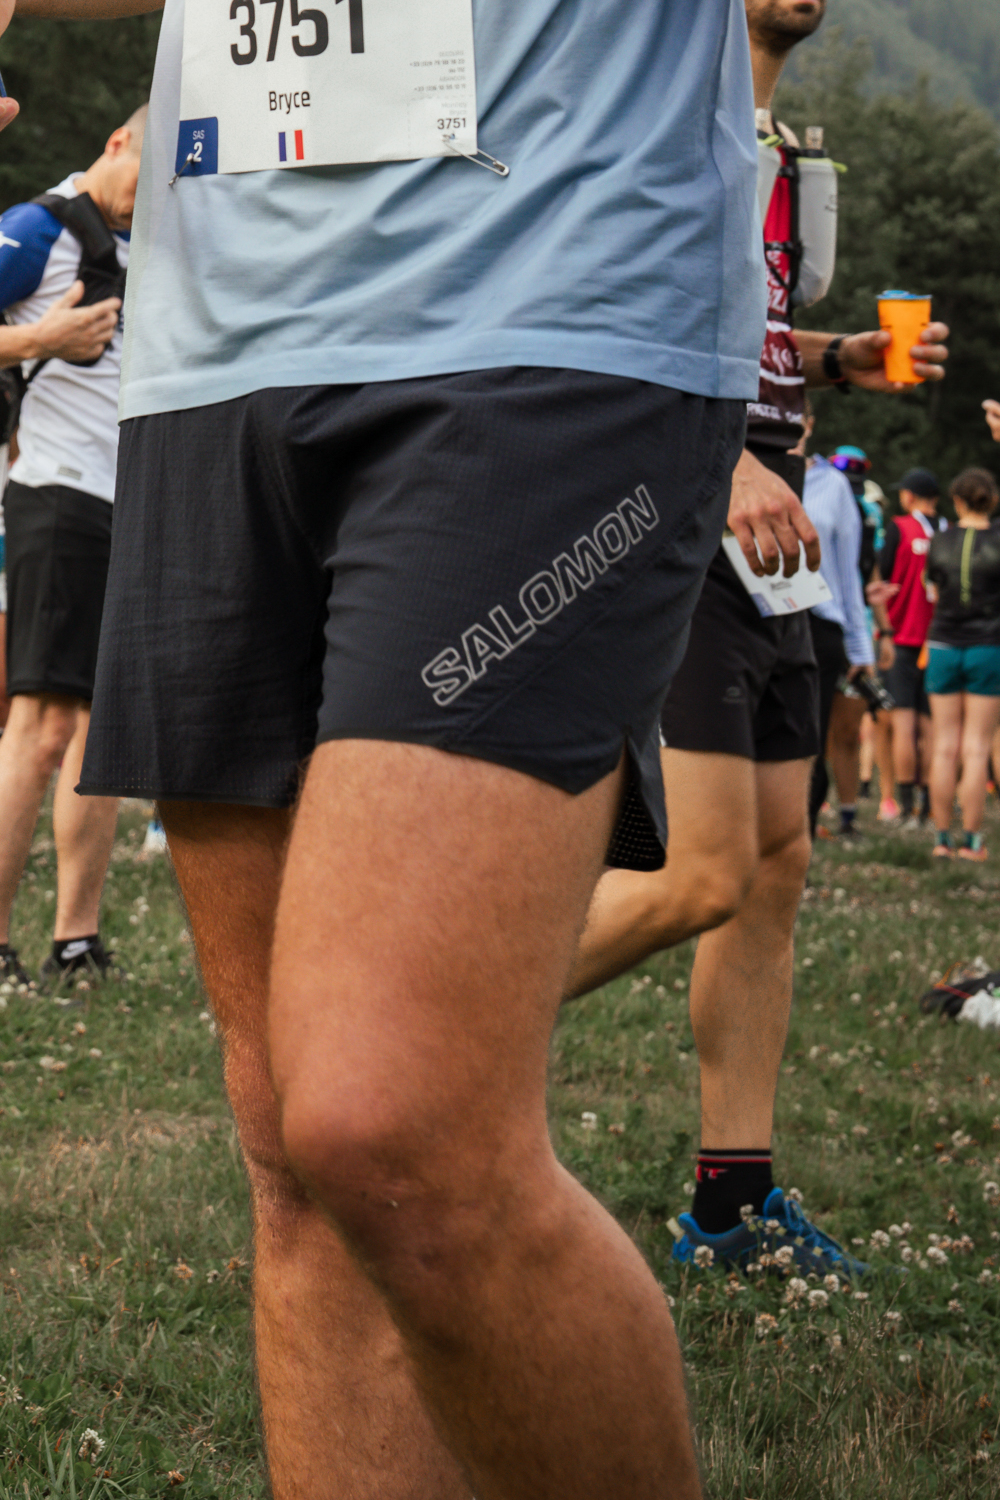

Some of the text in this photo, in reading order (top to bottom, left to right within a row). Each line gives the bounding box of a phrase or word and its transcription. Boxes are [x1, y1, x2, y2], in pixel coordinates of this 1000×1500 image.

[269, 90, 311, 115] Bryce
[437, 117, 466, 130] 3751
[192, 129, 205, 141] SAS
[193, 141, 203, 162] 2
[421, 483, 660, 707] SALOMON
